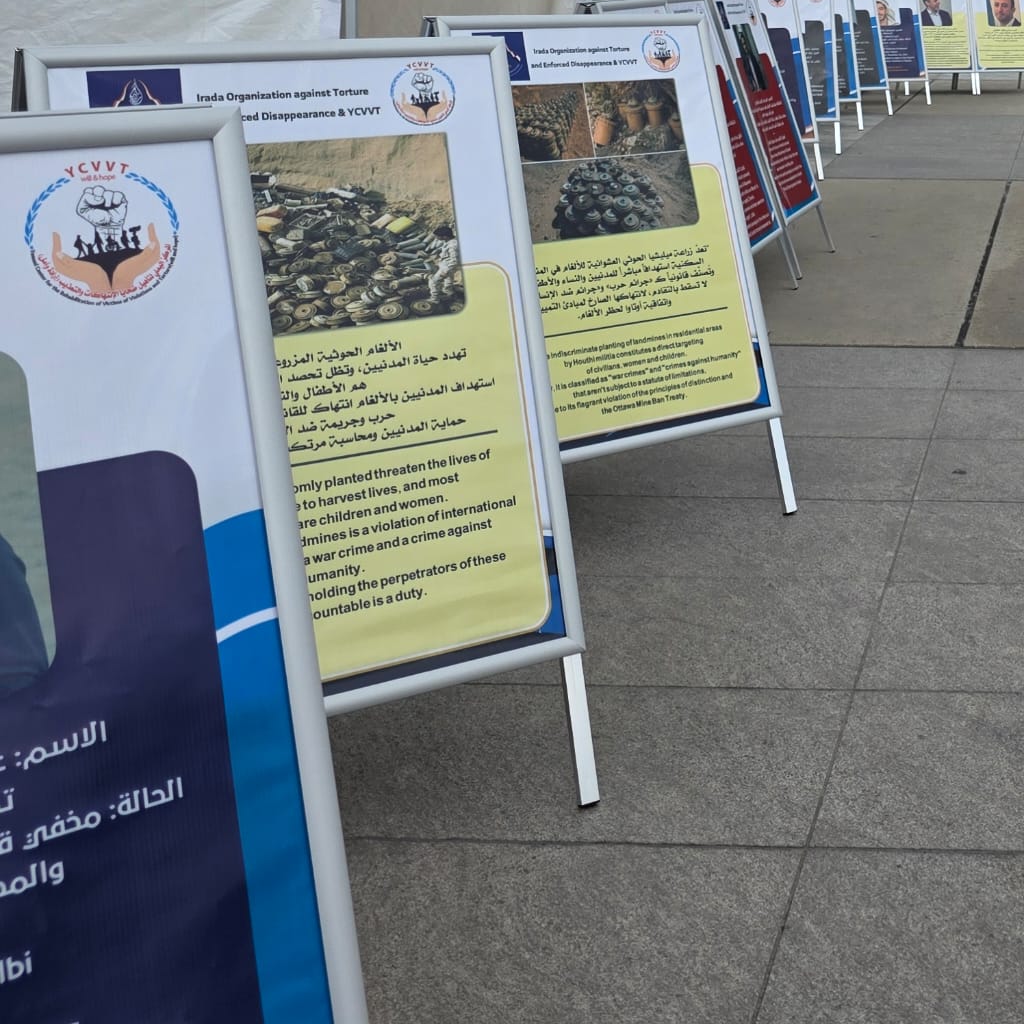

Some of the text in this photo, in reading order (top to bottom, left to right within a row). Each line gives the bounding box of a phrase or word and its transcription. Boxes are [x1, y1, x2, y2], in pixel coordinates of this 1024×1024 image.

[543, 61, 570, 69] Enforced
[571, 60, 613, 69] Disappearance
[550, 47, 587, 55] Organization
[588, 47, 608, 55] against
[196, 87, 369, 103] Irada Organization against Torture
[261, 109, 336, 122] Disappearance
[338, 109, 346, 117] &
[347, 107, 381, 116] YCVVT
[64, 160, 129, 178] YCVVT
[276, 354, 313, 369] المزروع
[293, 448, 491, 495] omly planted threaten the lives of
[303, 498, 317, 511] to
[318, 488, 366, 508] harvest
[369, 483, 401, 498] lives,
[403, 478, 426, 493] and
[428, 472, 459, 487] most
[301, 496, 517, 548] dmines is a violation of international
[319, 507, 372, 526] children
[373, 501, 397, 515] and
[398, 494, 448, 511] women.
[304, 518, 493, 566] a war crime and a crime against
[308, 563, 365, 584] umanity.
[358, 578, 378, 592] the
[380, 563, 458, 589] perpetrators
[459, 556, 472, 570] of
[471, 551, 506, 565] these
[313, 587, 427, 620] ountable is a duty.
[109, 777, 184, 821] الحالة:
[23, 811, 102, 851] مخفي
